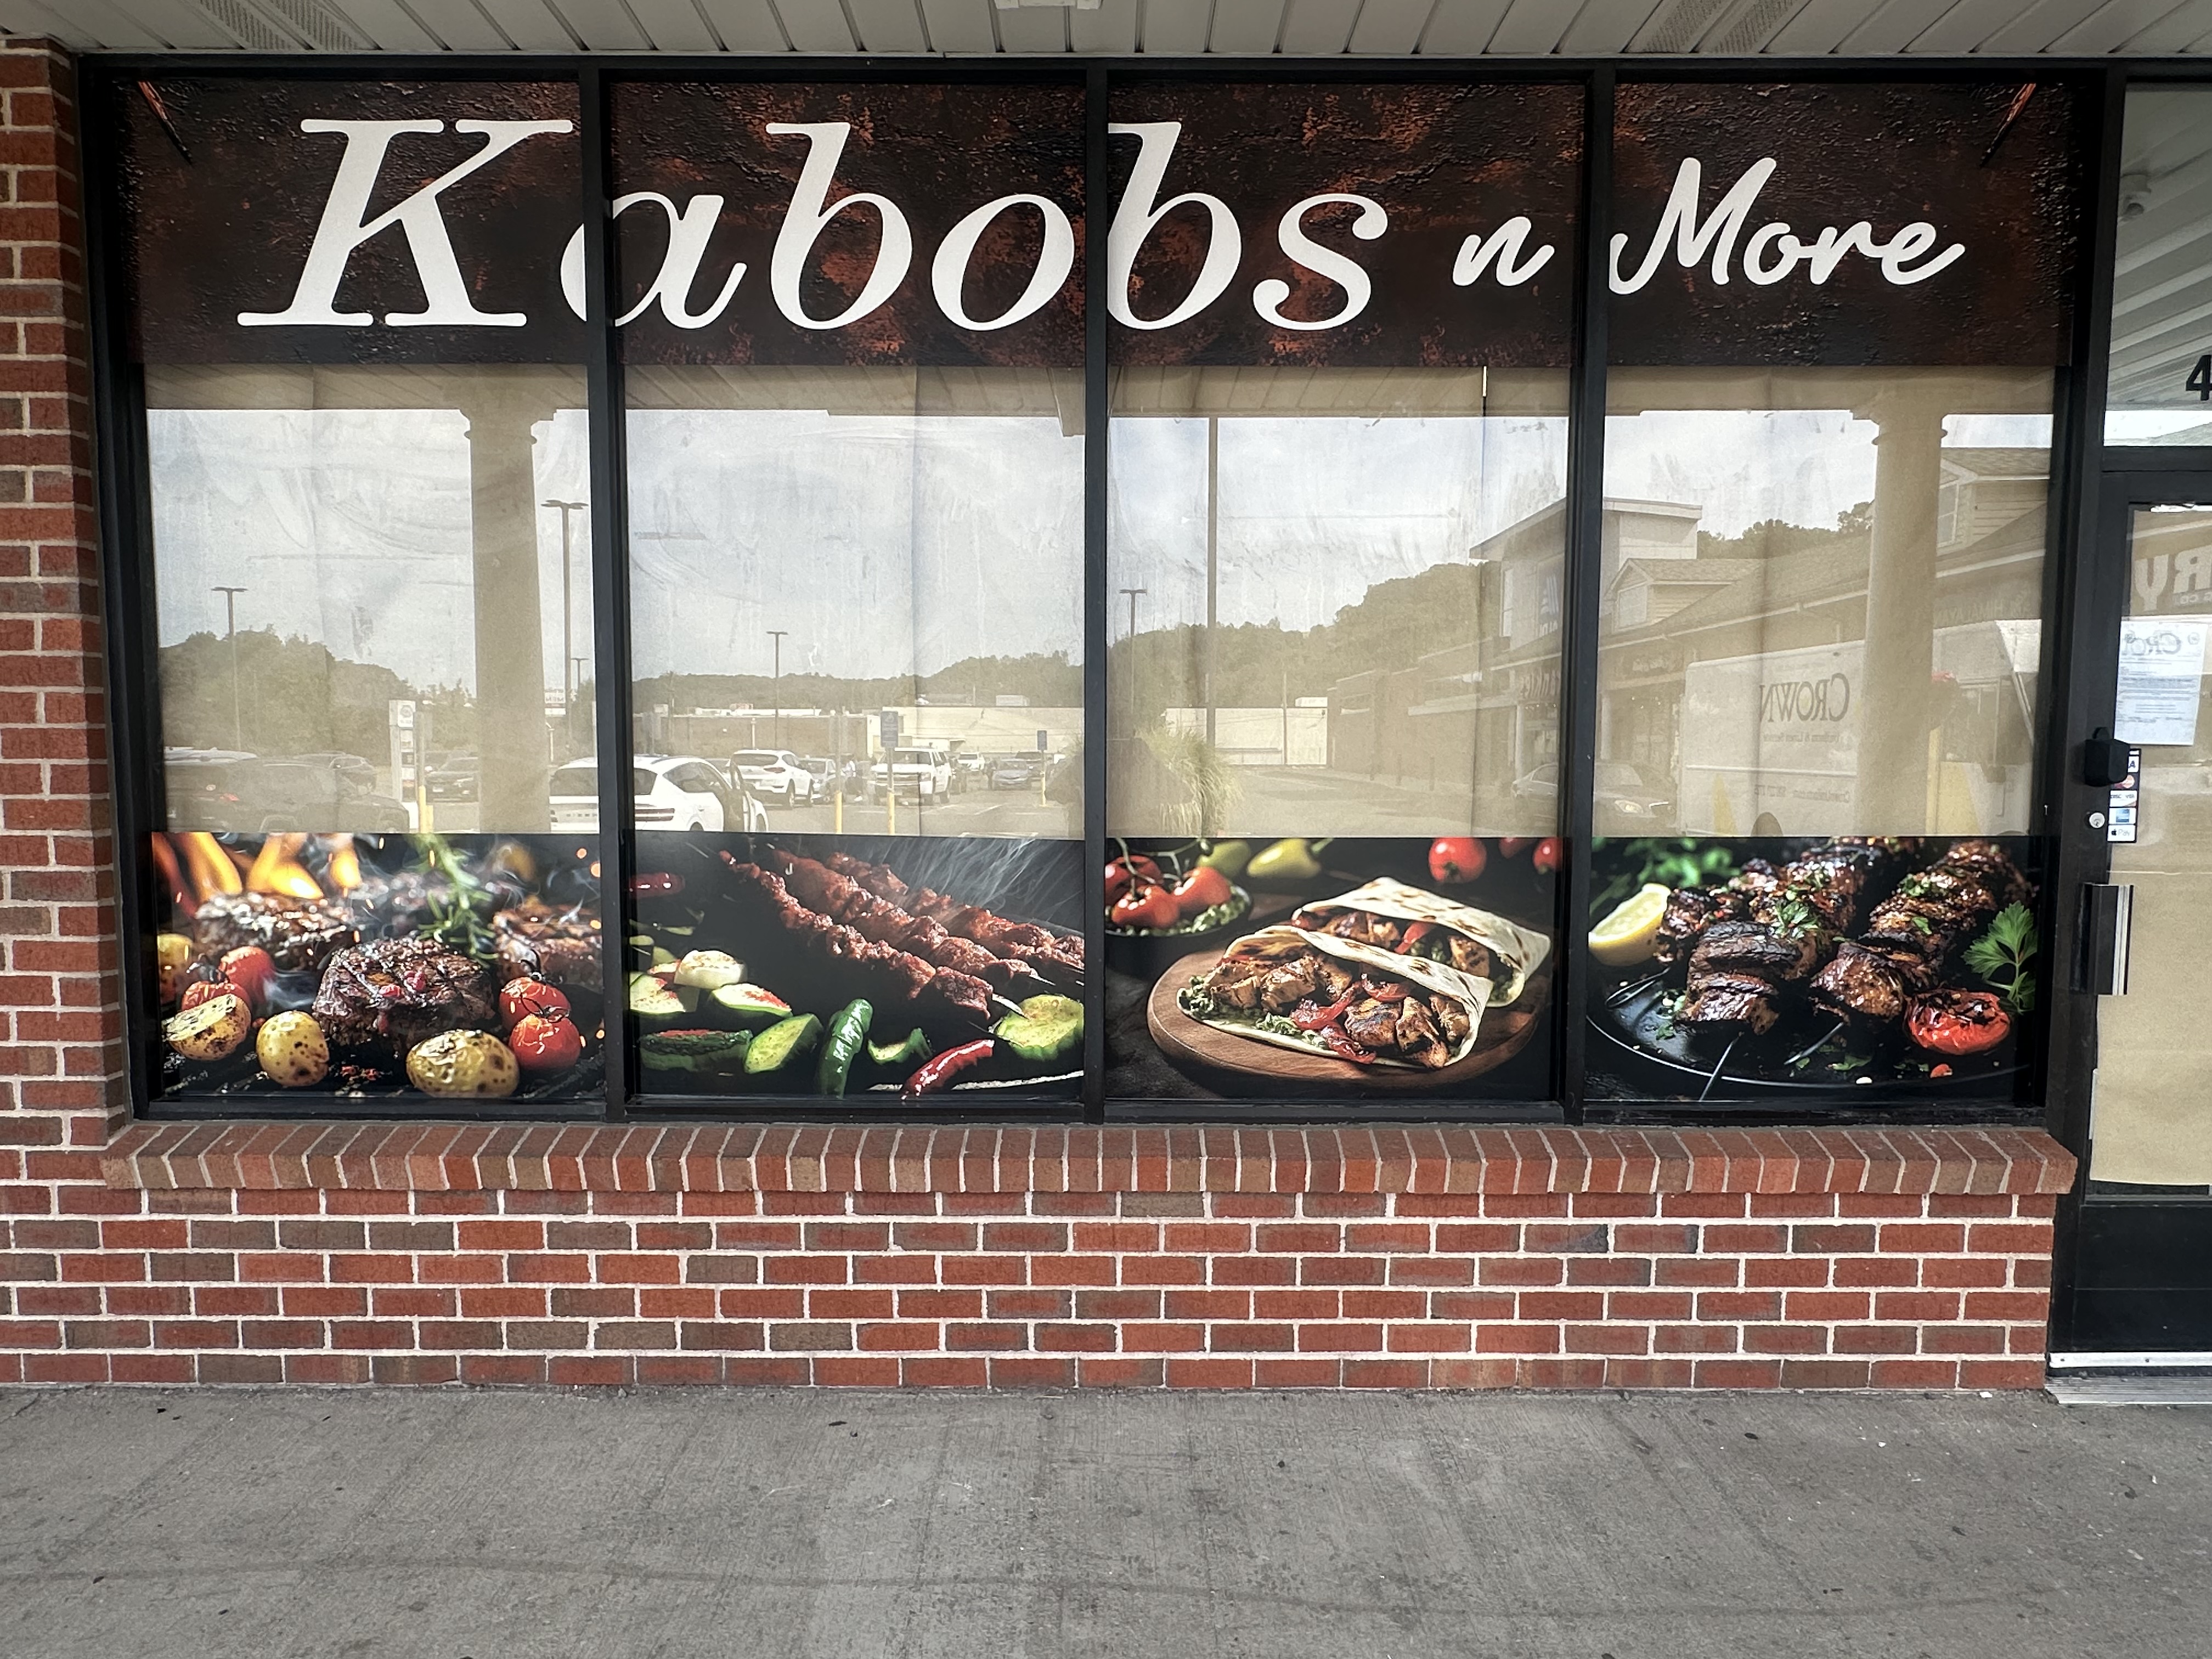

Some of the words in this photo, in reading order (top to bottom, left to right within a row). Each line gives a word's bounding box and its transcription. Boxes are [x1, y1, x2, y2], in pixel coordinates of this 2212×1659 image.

[236, 119, 1389, 331] Kabobs
[1452, 216, 1555, 287] n
[1609, 157, 1965, 295] More
[2185, 354, 2212, 401] 4
